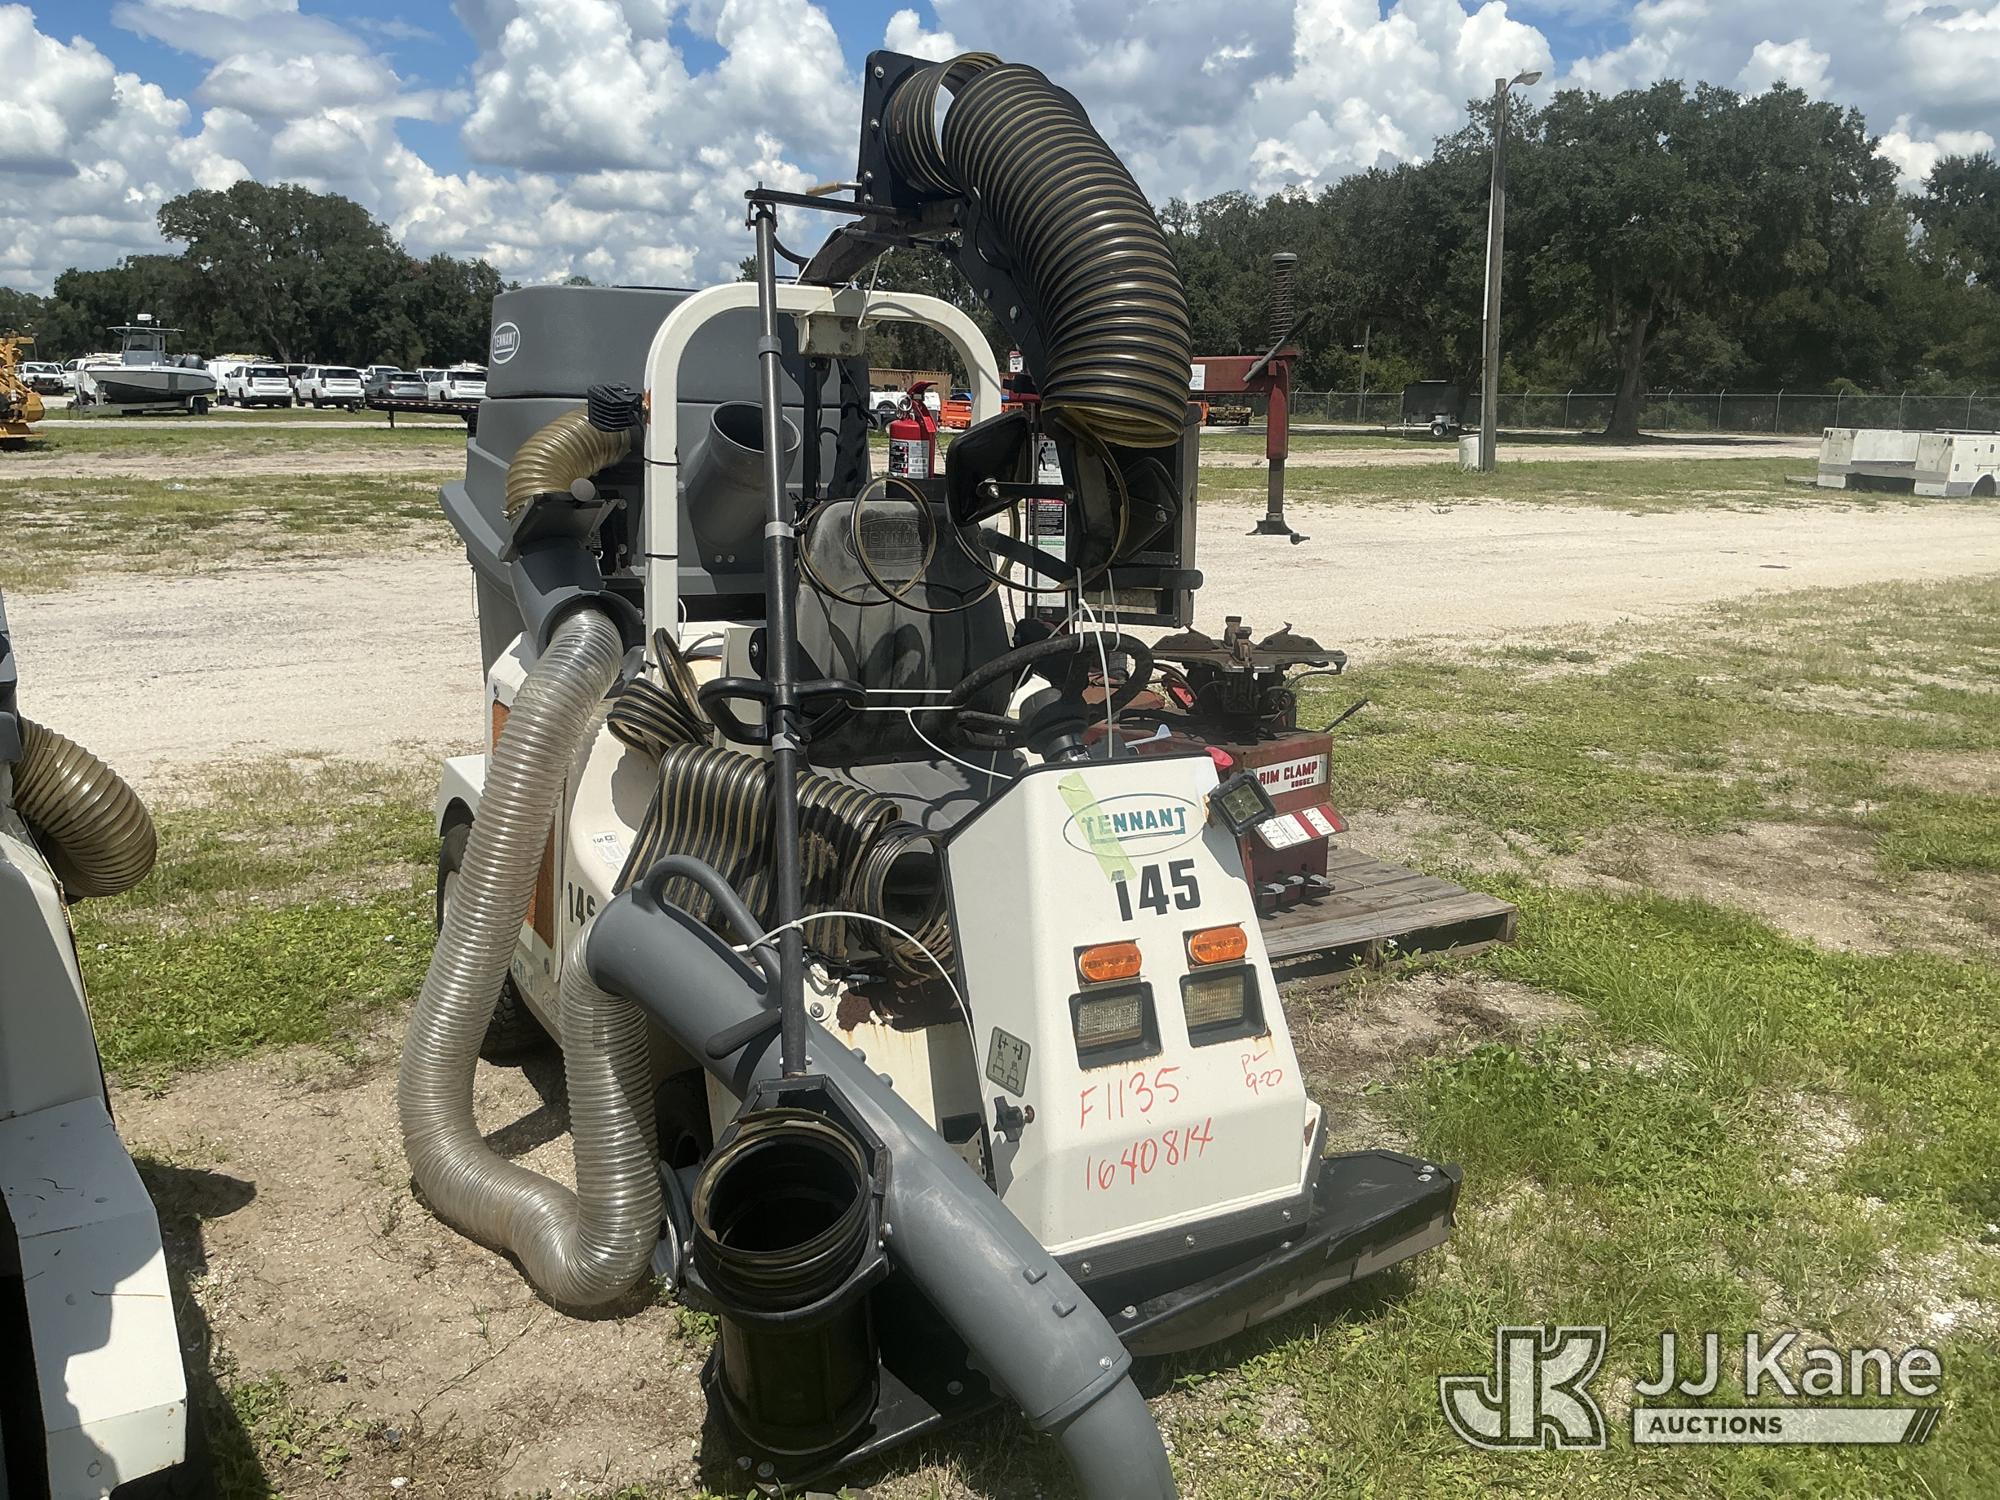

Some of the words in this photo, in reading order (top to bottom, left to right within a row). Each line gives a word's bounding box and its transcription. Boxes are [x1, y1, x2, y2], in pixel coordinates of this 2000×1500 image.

[494, 331, 517, 354] TENNANT
[1284, 761, 1318, 780] CLAMP
[1081, 807, 1187, 845] TENNANT
[1110, 858, 1201, 922] 145
[1080, 1066, 1181, 1130] F1135
[1086, 1116, 1214, 1192] 1640814
